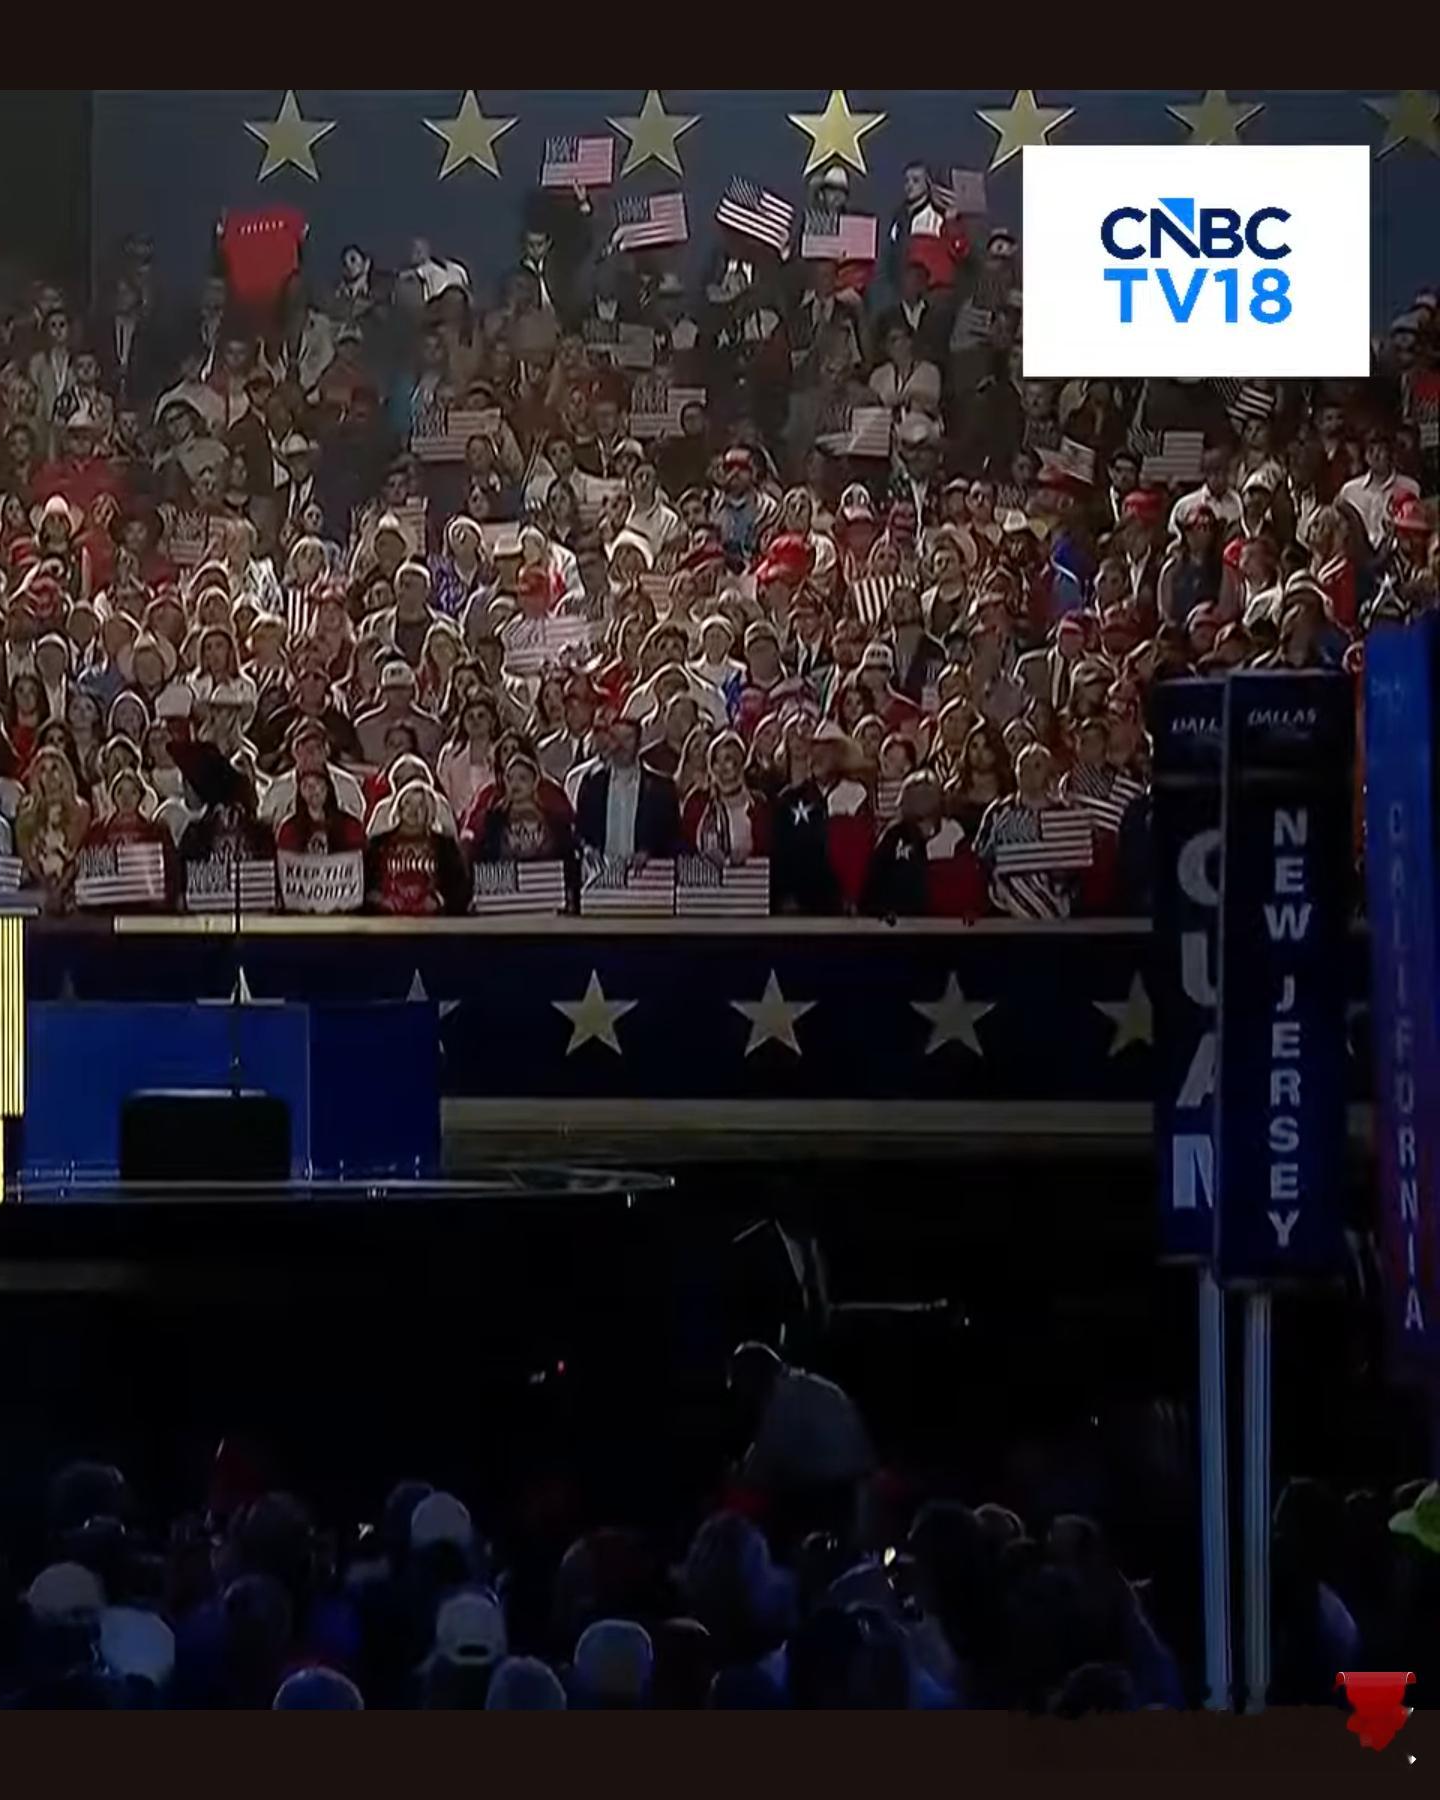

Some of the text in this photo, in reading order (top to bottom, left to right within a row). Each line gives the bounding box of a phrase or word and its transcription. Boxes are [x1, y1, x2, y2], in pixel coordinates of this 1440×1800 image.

[1171, 715, 1220, 734] DALL
[1262, 807, 1312, 1248] NEW JERSEY
